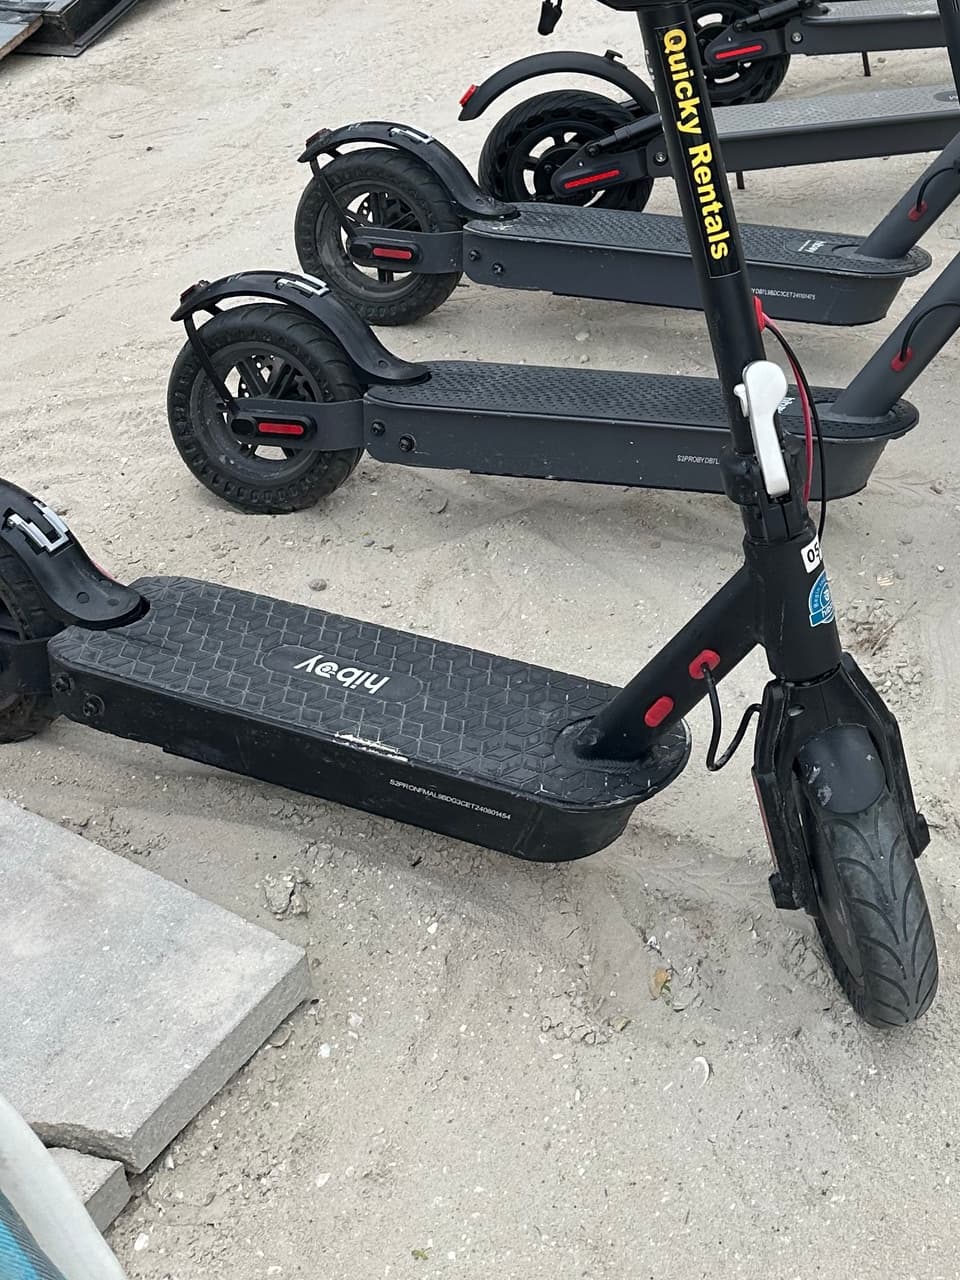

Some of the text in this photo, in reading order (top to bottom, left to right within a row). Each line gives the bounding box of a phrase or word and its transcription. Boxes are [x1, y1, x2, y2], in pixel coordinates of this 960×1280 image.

[663, 28, 730, 261] Quicky Rentals
[293, 654, 391, 695] hiboy
